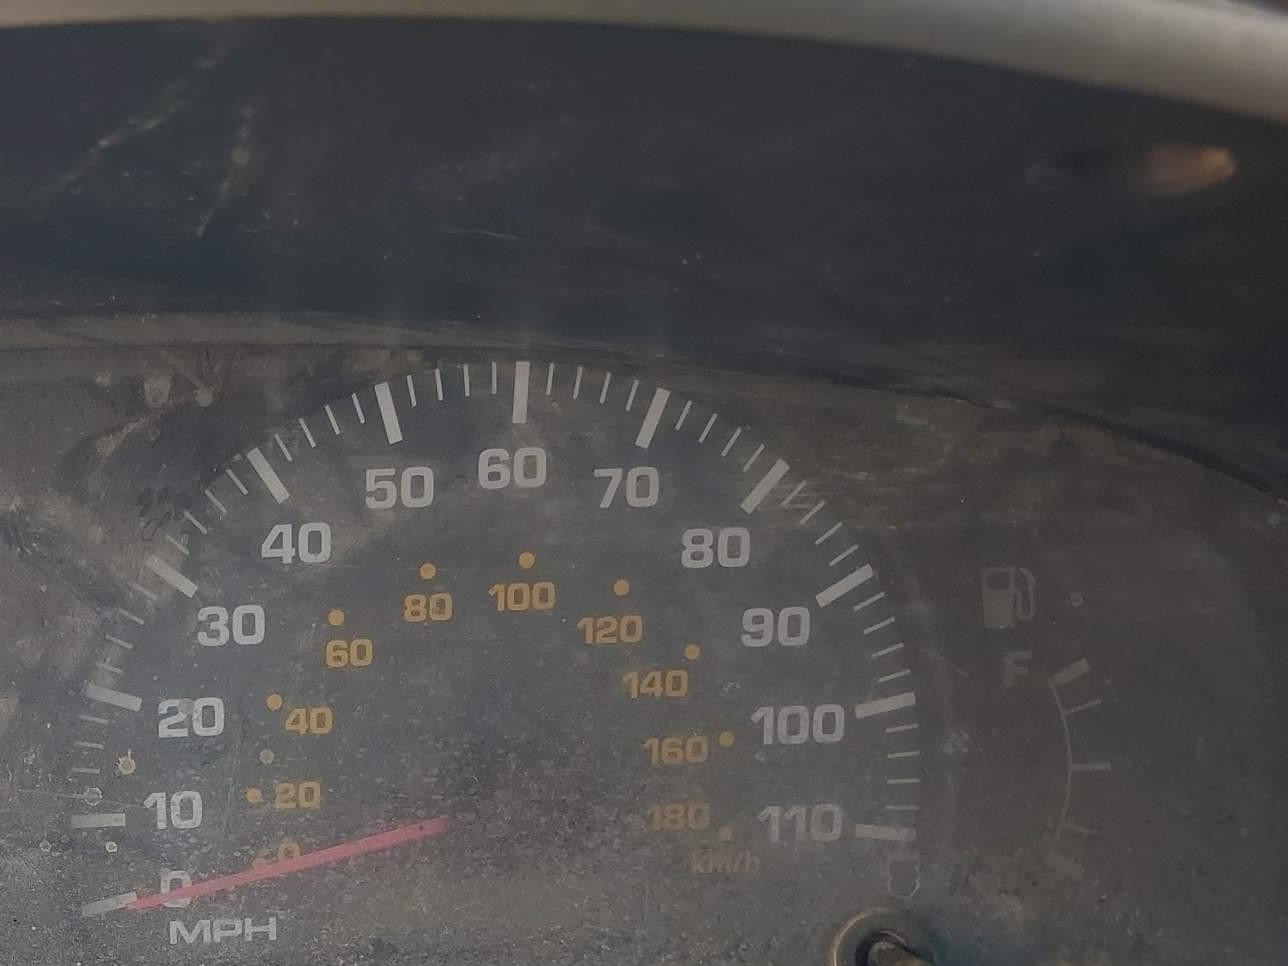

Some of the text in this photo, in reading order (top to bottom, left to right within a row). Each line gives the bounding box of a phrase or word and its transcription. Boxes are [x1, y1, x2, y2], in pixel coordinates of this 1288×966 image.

[365, 466, 434, 510] 50
[478, 446, 548, 489] 60
[594, 466, 661, 509] 70
[261, 522, 332, 564] 40
[681, 526, 751, 569] 80
[403, 592, 453, 623] 80
[488, 582, 556, 612] 100
[197, 604, 266, 648] 30
[577, 614, 644, 645] 120
[741, 606, 811, 648] 90
[325, 638, 374, 669] 60
[1002, 650, 1034, 688] F
[621, 670, 689, 700] 140
[158, 696, 225, 739] 20
[284, 706, 333, 736] 40
[750, 703, 846, 746] 100
[643, 734, 710, 766] 160
[143, 790, 203, 831] 10
[274, 780, 321, 810] 20
[756, 803, 843, 844] 110
[168, 916, 278, 945] MPH
